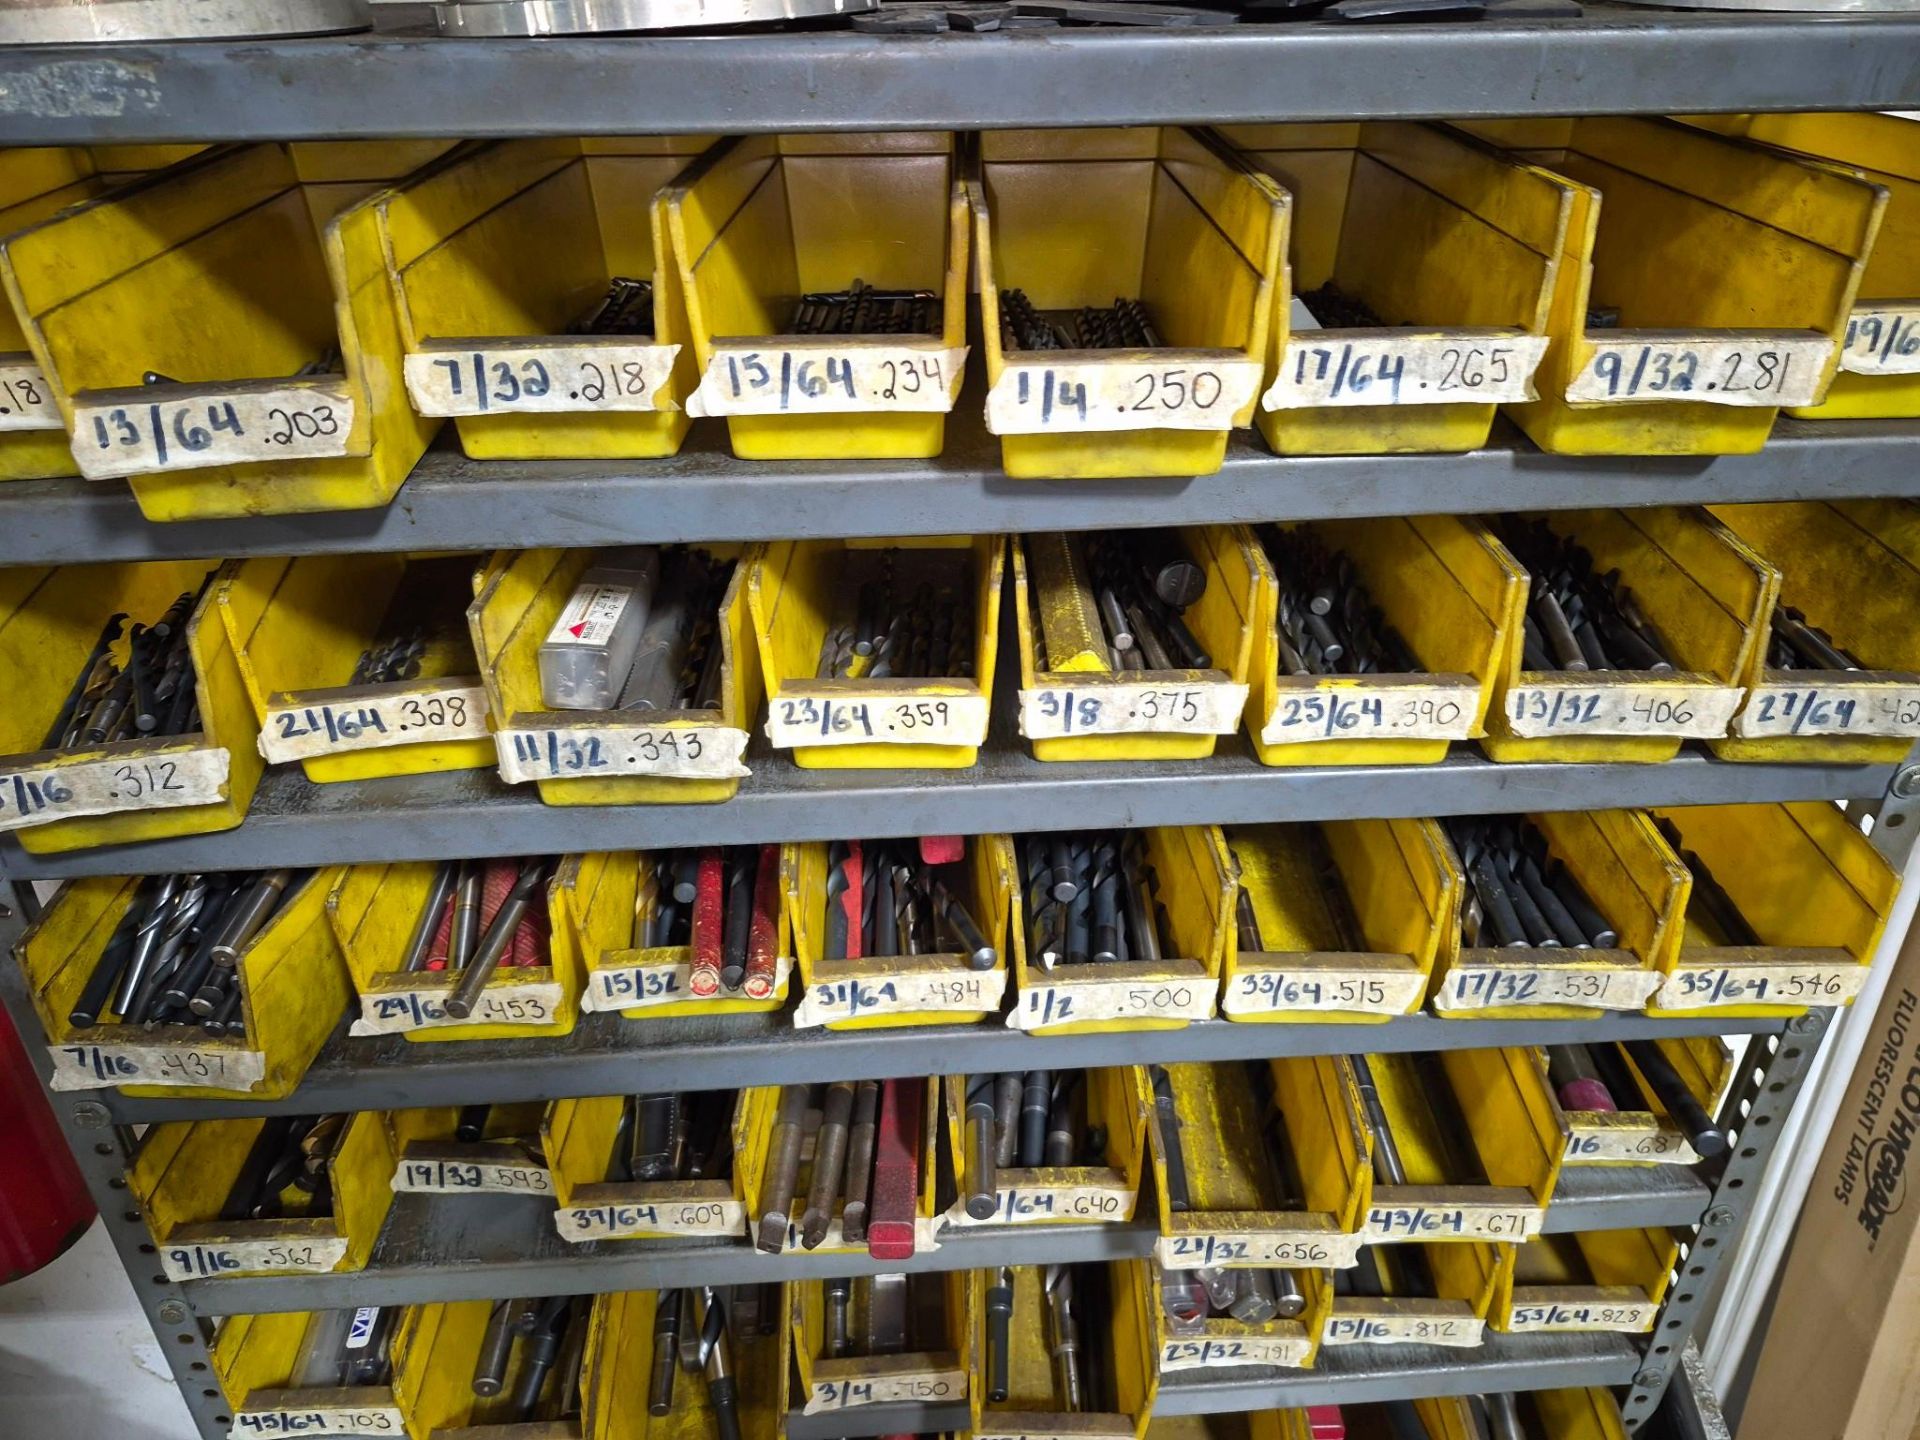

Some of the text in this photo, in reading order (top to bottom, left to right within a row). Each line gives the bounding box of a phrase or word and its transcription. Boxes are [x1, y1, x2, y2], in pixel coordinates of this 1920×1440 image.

[433, 353, 646, 410] 7/32 .218
[727, 352, 943, 409] 15/64 .234
[1295, 344, 1514, 403] 17/64 .265
[1594, 346, 1791, 396] 9/32 .281
[0, 376, 46, 415] .18
[1018, 370, 1223, 424] 1/4 .250
[93, 403, 338, 465] 13/64 .203
[275, 696, 467, 742] 21/64 .328
[780, 696, 949, 736] 23/64 .359
[1037, 690, 1202, 733] 3/8 .375
[1281, 694, 1461, 737] 25/64 .390
[1515, 691, 1695, 727] 13/32 .406
[1757, 690, 1856, 734] 27/64
[514, 731, 702, 775] 11/32 .343
[110, 762, 185, 799] .312
[603, 969, 681, 999] 15/32
[817, 979, 981, 1015] 31/64 .484
[1242, 974, 1385, 1007] 33/64 .515
[1456, 971, 1611, 1004] 17/32 .531
[1678, 969, 1842, 1003] 35/64 .546
[373, 993, 546, 1026] 29/6 .453
[1030, 987, 1192, 1025] 1/2 .500
[63, 1047, 225, 1081] 7/16 .437
[1834, 987, 1918, 1206] FLUORESCENT LAMPS
[1625, 1135, 1684, 1154] .687
[406, 1162, 483, 1188] 19/32
[1857, 1107, 1919, 1243] HYGRADE
[571, 1203, 725, 1231] 39/64 .609
[1064, 1196, 1119, 1214] .640
[1370, 1208, 1526, 1236] 43/64 .671
[169, 1246, 322, 1276] 9/16 .562
[1173, 1236, 1328, 1265] 21/32 .656
[1329, 1318, 1457, 1339] 13/16 .812
[1514, 1305, 1641, 1325] 53/64 .828
[1165, 1341, 1248, 1364] 25/32
[817, 1380, 950, 1402] 3/4 .750
[239, 1412, 391, 1433] 45/64 .703
